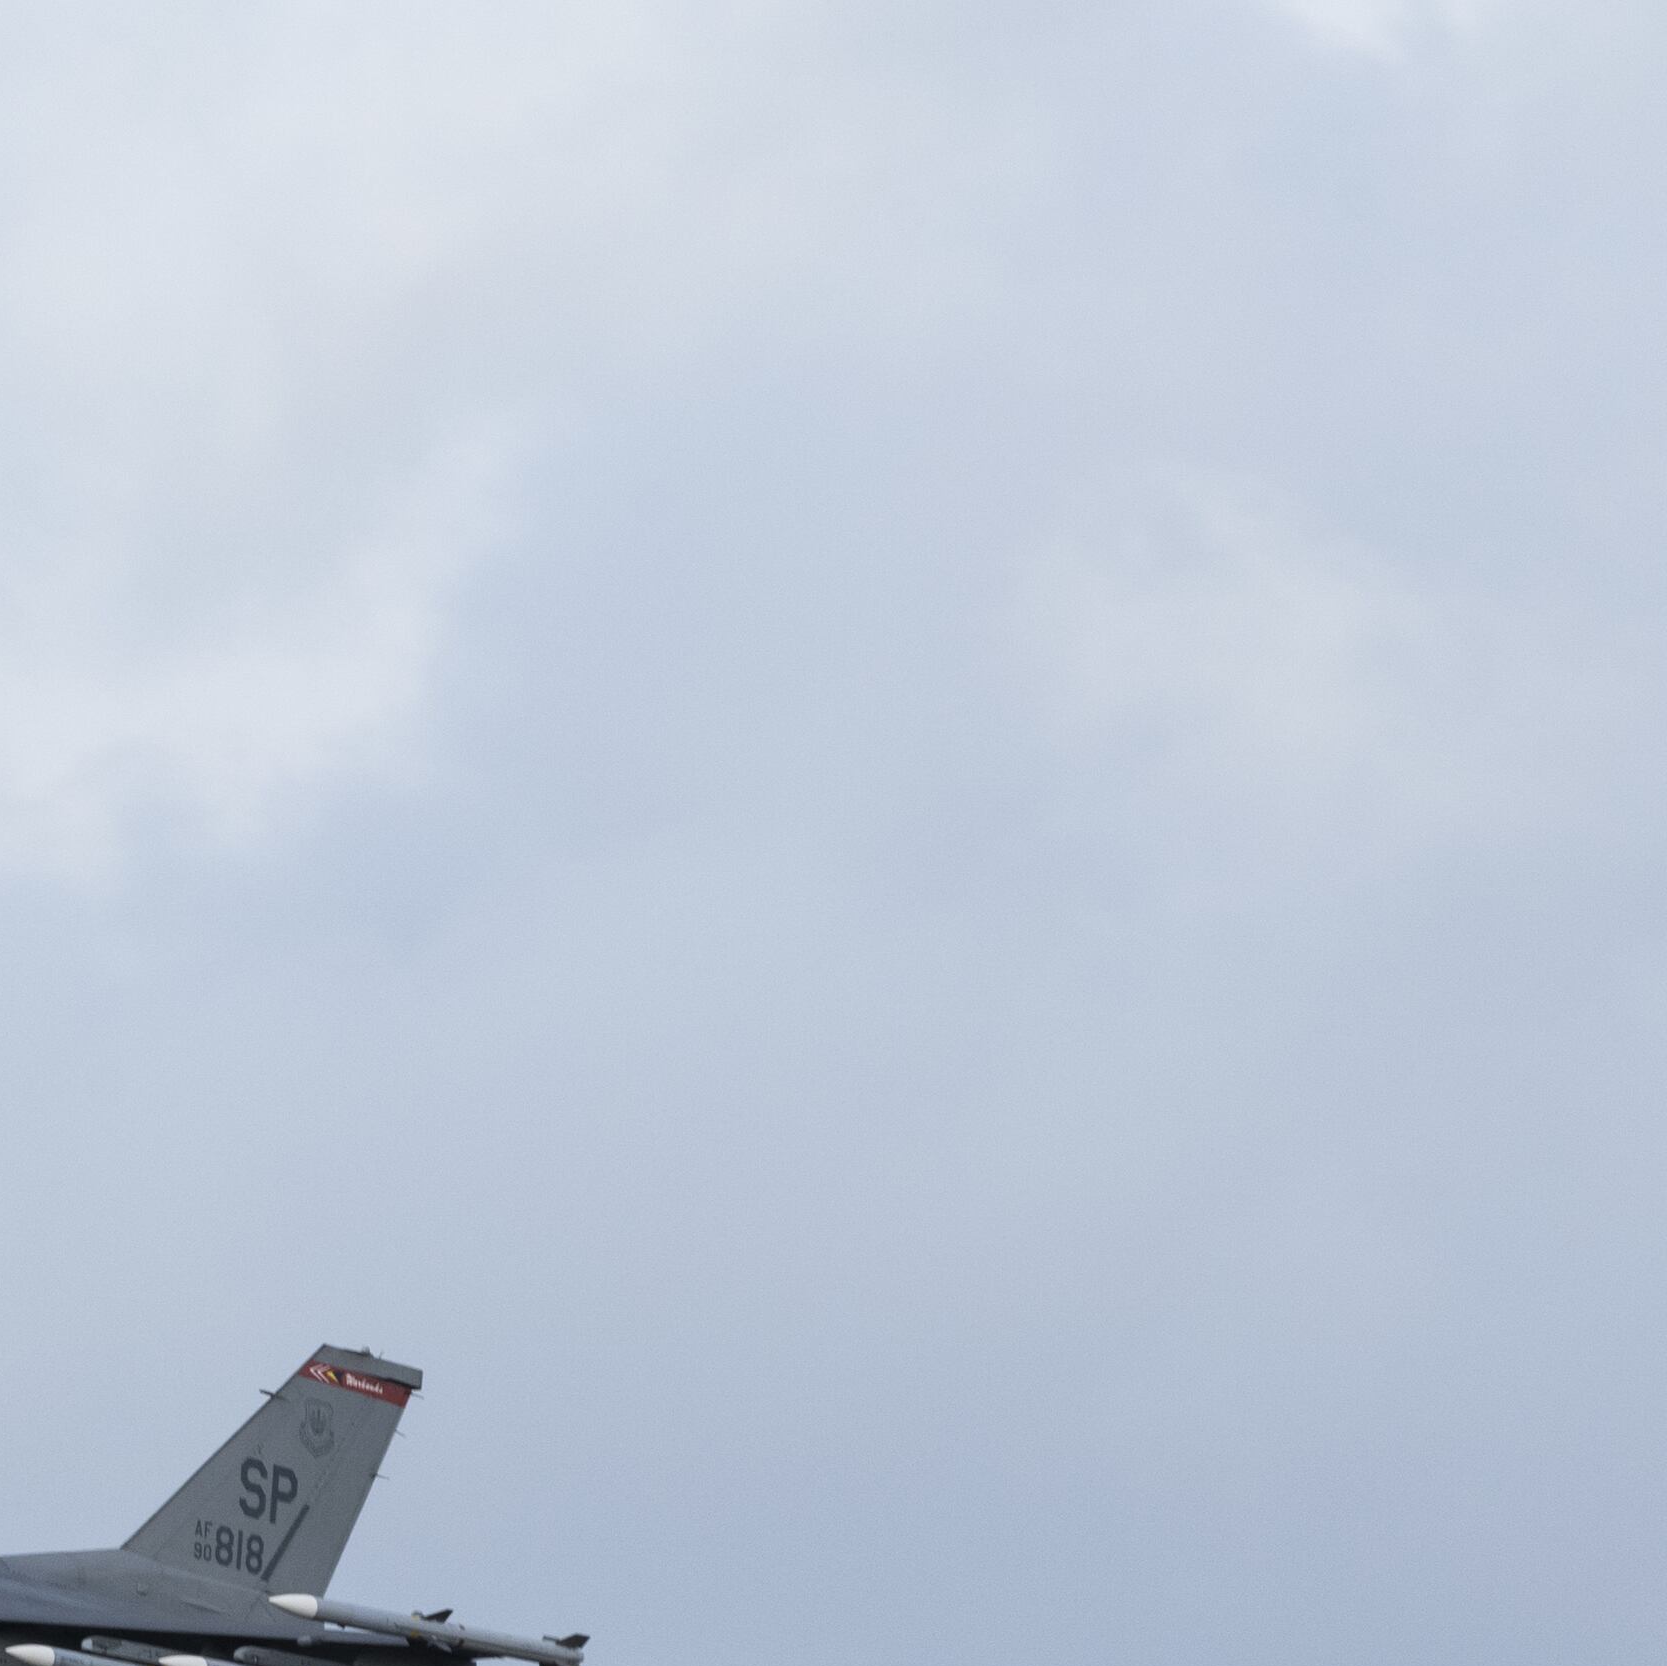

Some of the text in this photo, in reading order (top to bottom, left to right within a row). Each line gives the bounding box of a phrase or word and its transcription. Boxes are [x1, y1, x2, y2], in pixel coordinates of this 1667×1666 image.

[239, 1458, 298, 1524] SP
[195, 1519, 213, 1537] AF
[193, 1541, 212, 1562] 90
[215, 1525, 264, 1575] 818
